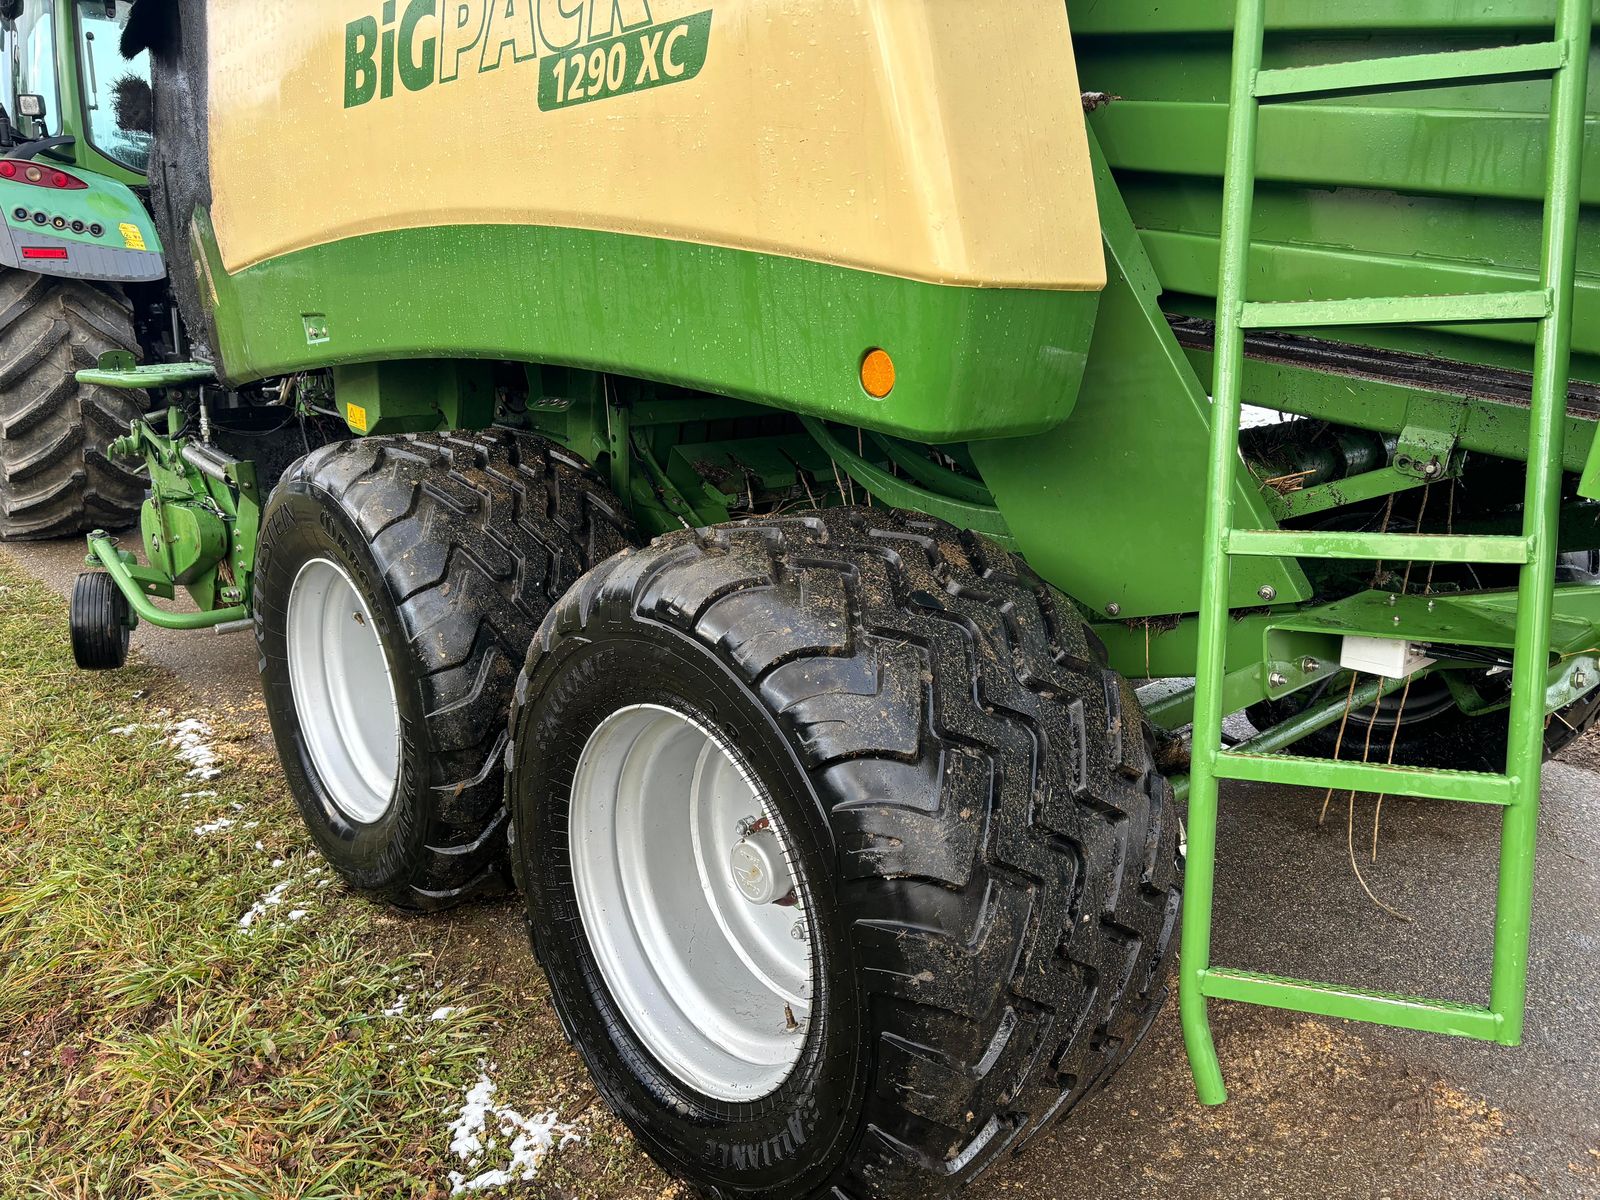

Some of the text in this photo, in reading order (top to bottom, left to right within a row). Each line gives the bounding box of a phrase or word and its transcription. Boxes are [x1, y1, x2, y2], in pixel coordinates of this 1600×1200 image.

[551, 25, 689, 103] 1290 XC
[702, 1108, 808, 1171] ALLIANCE
